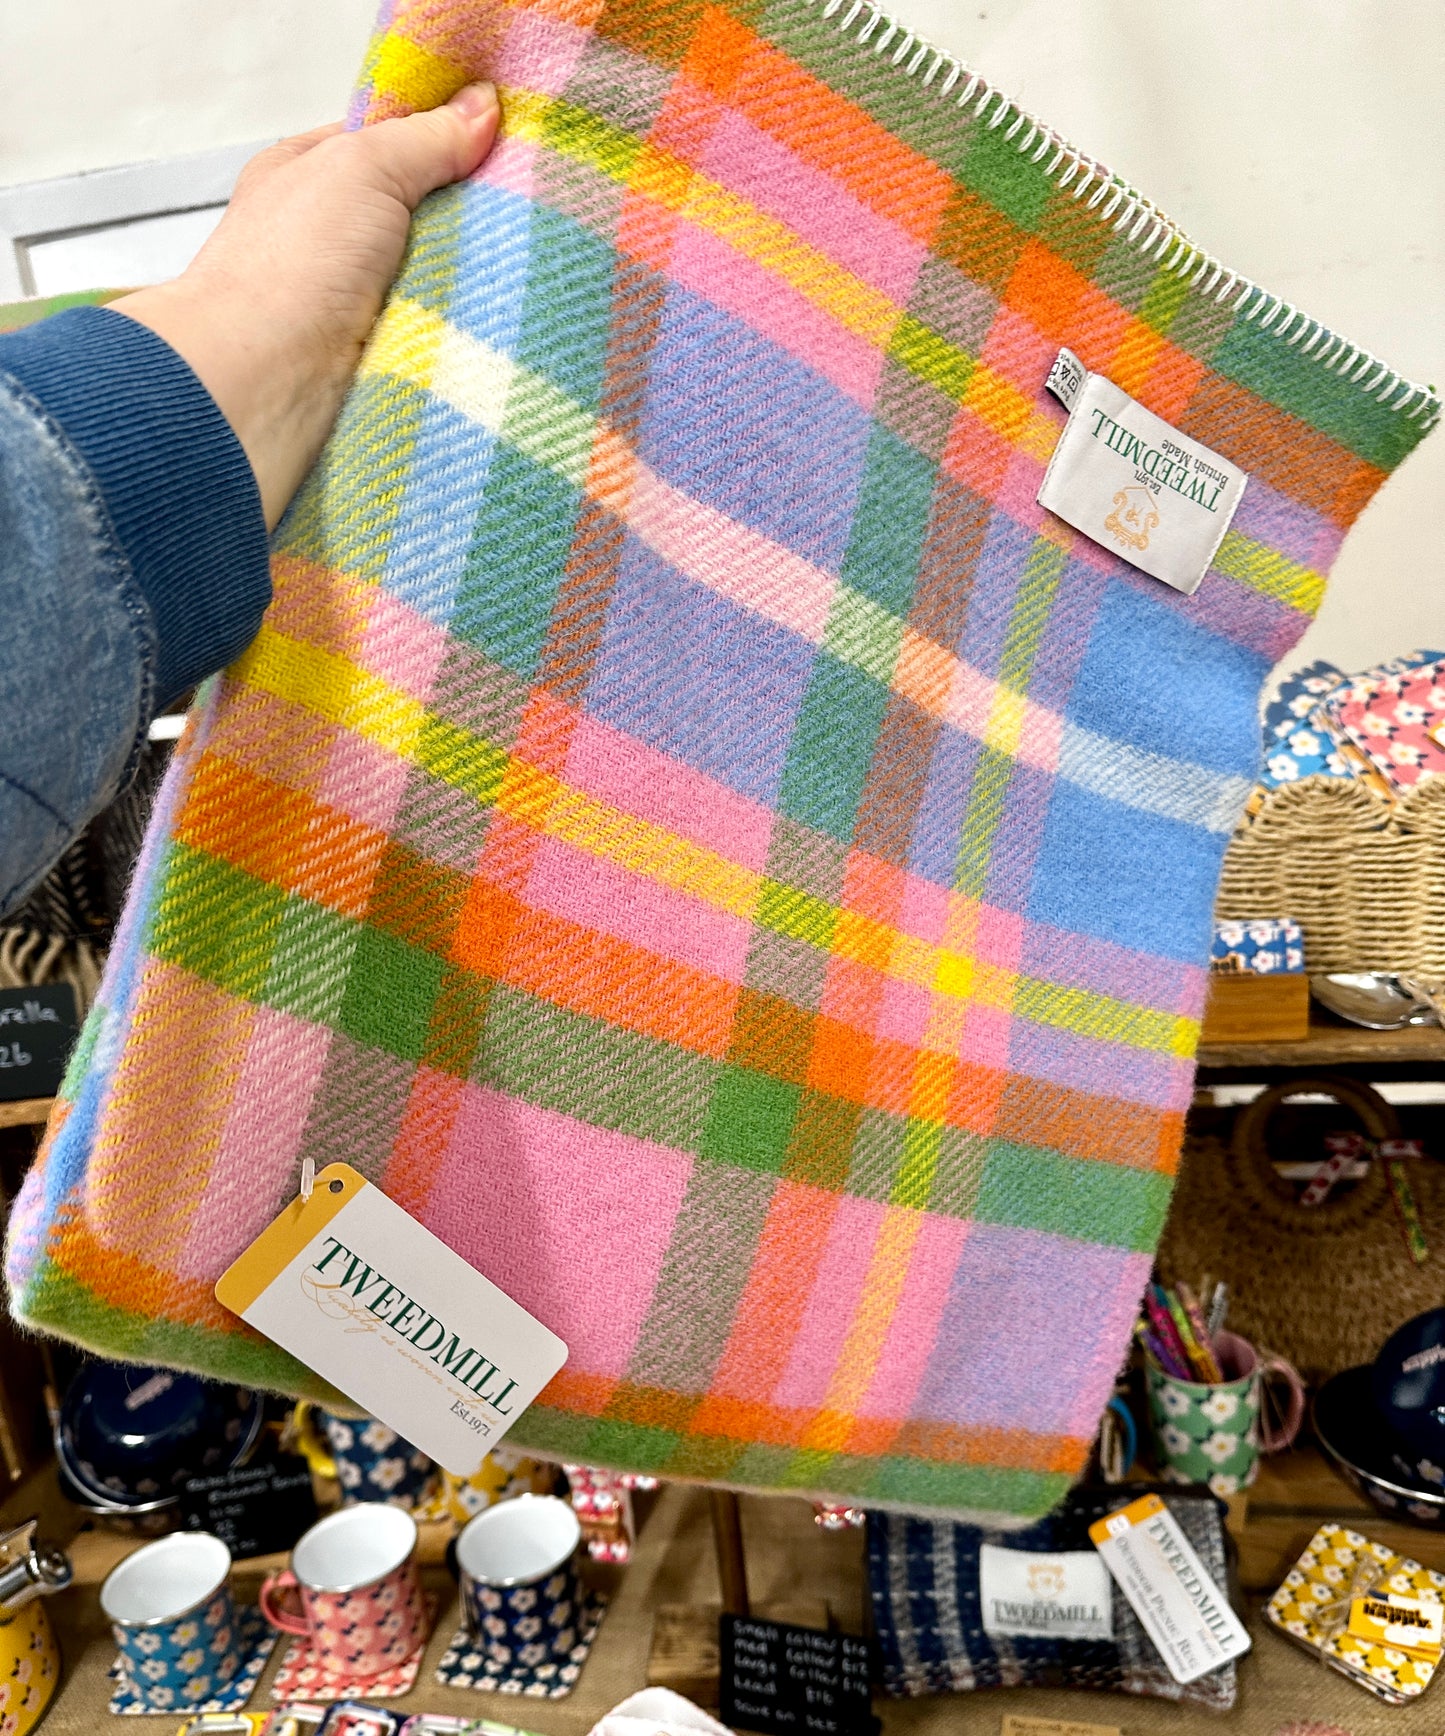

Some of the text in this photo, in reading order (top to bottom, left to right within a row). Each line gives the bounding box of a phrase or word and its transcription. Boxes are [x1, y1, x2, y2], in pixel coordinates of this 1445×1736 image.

[1091, 408, 1222, 512] TWEEDMILL
[1161, 439, 1229, 490] British Made
[312, 1236, 520, 1416] TWEEDMILL
[990, 1598, 1104, 1622] TWEEDMILL
[1149, 1516, 1236, 1653] TWEEDMILL
